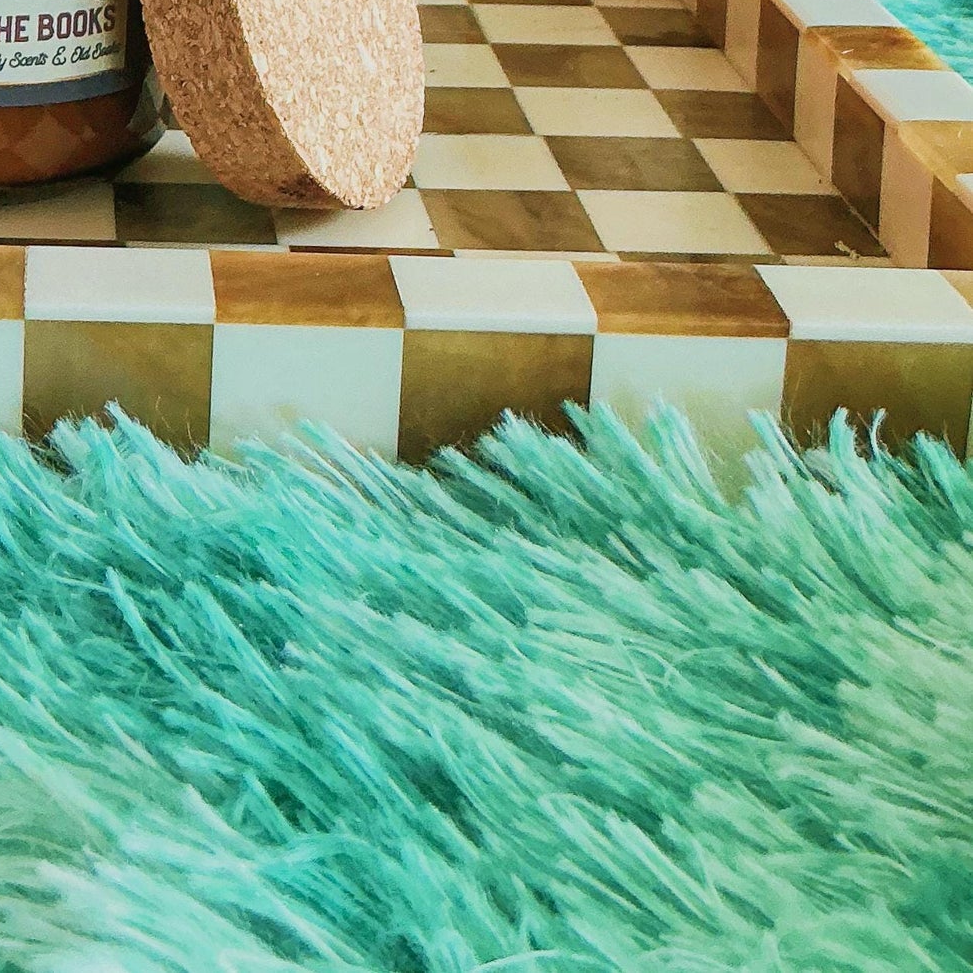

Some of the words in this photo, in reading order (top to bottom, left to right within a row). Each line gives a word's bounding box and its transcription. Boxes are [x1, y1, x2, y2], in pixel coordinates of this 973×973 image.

[37, 4, 116, 41] BOOKS
[9, 51, 48, 68] Scents
[51, 46, 67, 66] &
[70, 45, 92, 64] Old
